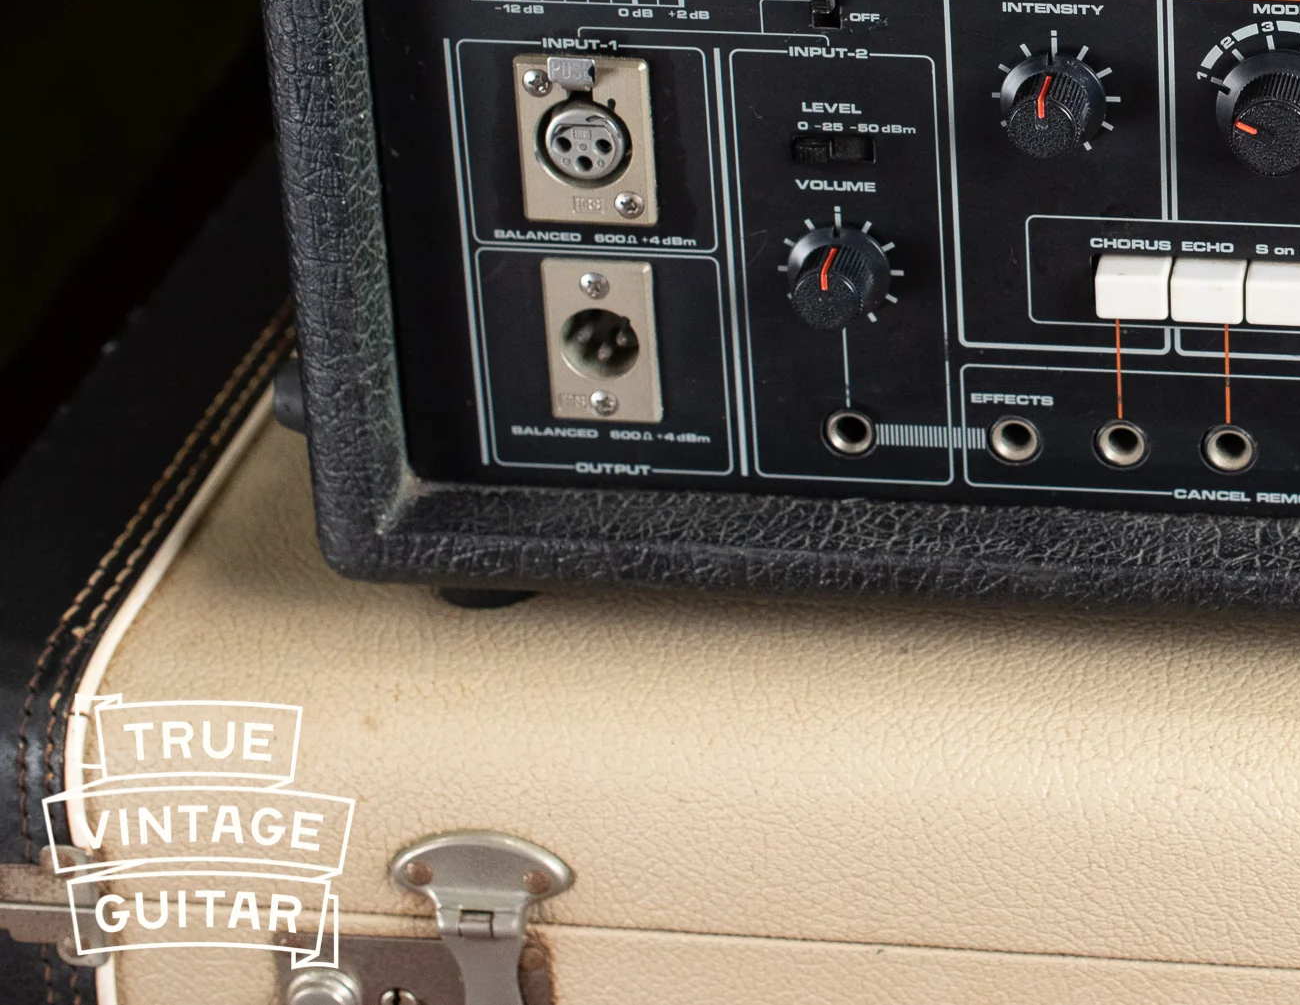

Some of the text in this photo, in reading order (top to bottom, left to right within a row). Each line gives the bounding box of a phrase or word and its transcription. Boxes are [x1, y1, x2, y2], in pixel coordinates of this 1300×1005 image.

[495, 4, 544, 14] -12 dB
[618, 8, 653, 18] 0 dB
[1002, 1, 1104, 16] INTENSITY
[850, 12, 880, 22] OFF
[1220, 36, 1235, 51] 2
[1260, 21, 1275, 33] 3
[541, 37, 618, 51] INPUT-1
[788, 46, 869, 60] INPUT-2
[801, 102, 862, 115] LEVEL
[814, 122, 843, 132] -25
[850, 124, 879, 133] -50
[881, 124, 917, 135] dBm
[795, 179, 877, 193] VOLUME
[494, 229, 583, 243] BALANCED
[1090, 237, 1172, 252] CHORUS
[1181, 241, 1234, 253] ECHO
[1255, 244, 1269, 255] S
[1274, 246, 1295, 256] on
[970, 392, 1054, 407] EFFECTS
[511, 425, 599, 439] BALANCED
[575, 461, 651, 476] OUTPUT
[1173, 488, 1251, 503] CANCEL
